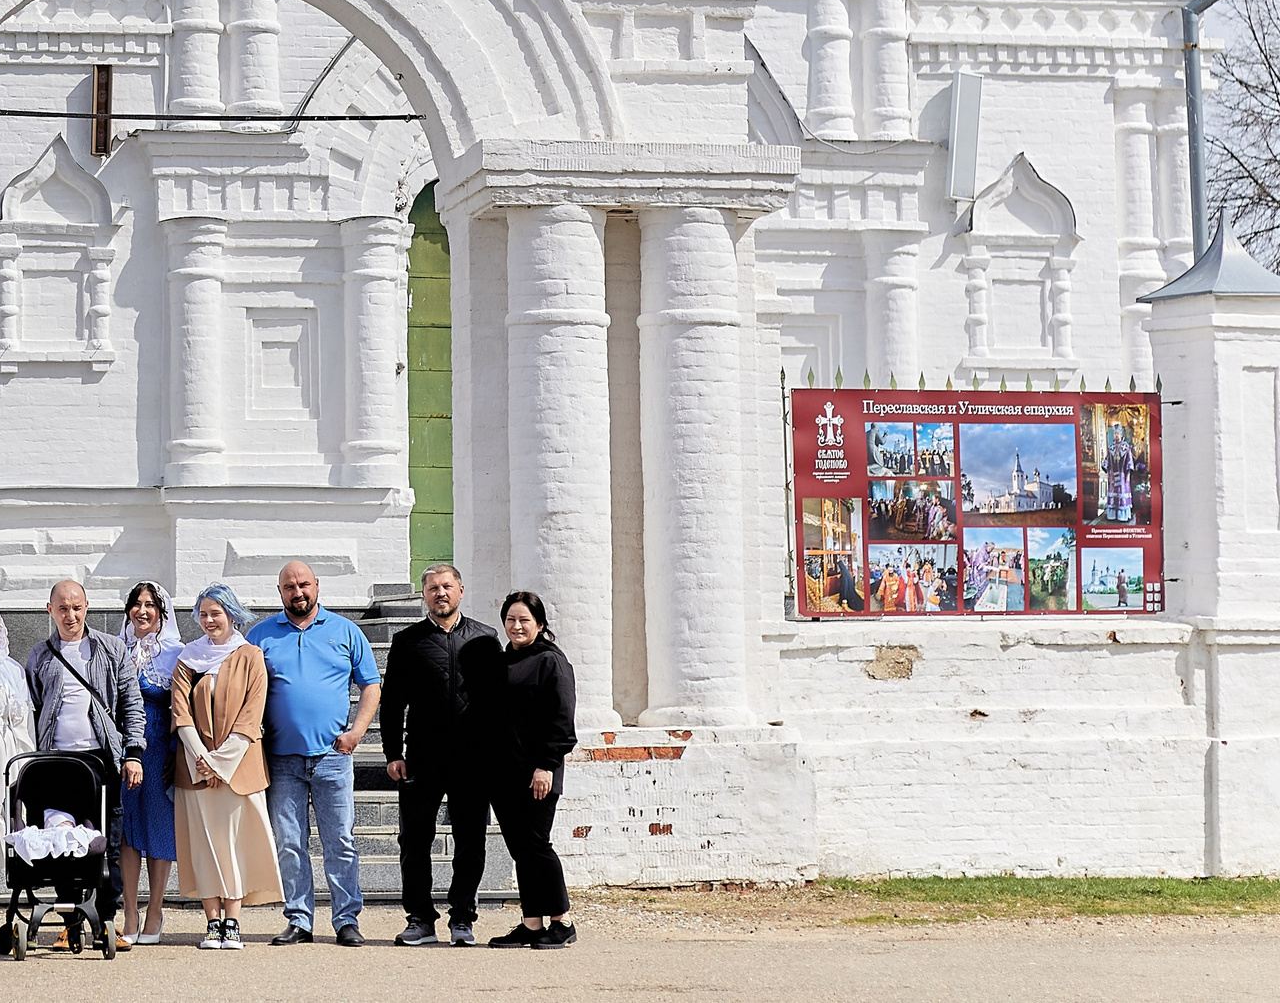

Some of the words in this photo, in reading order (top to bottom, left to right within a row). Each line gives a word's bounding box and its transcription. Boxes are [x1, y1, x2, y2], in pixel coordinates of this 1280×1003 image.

[862, 400, 946, 417] Переславская
[948, 405, 957, 414] и
[958, 401, 1023, 415] Угличская
[1024, 406, 1074, 419] епархия
